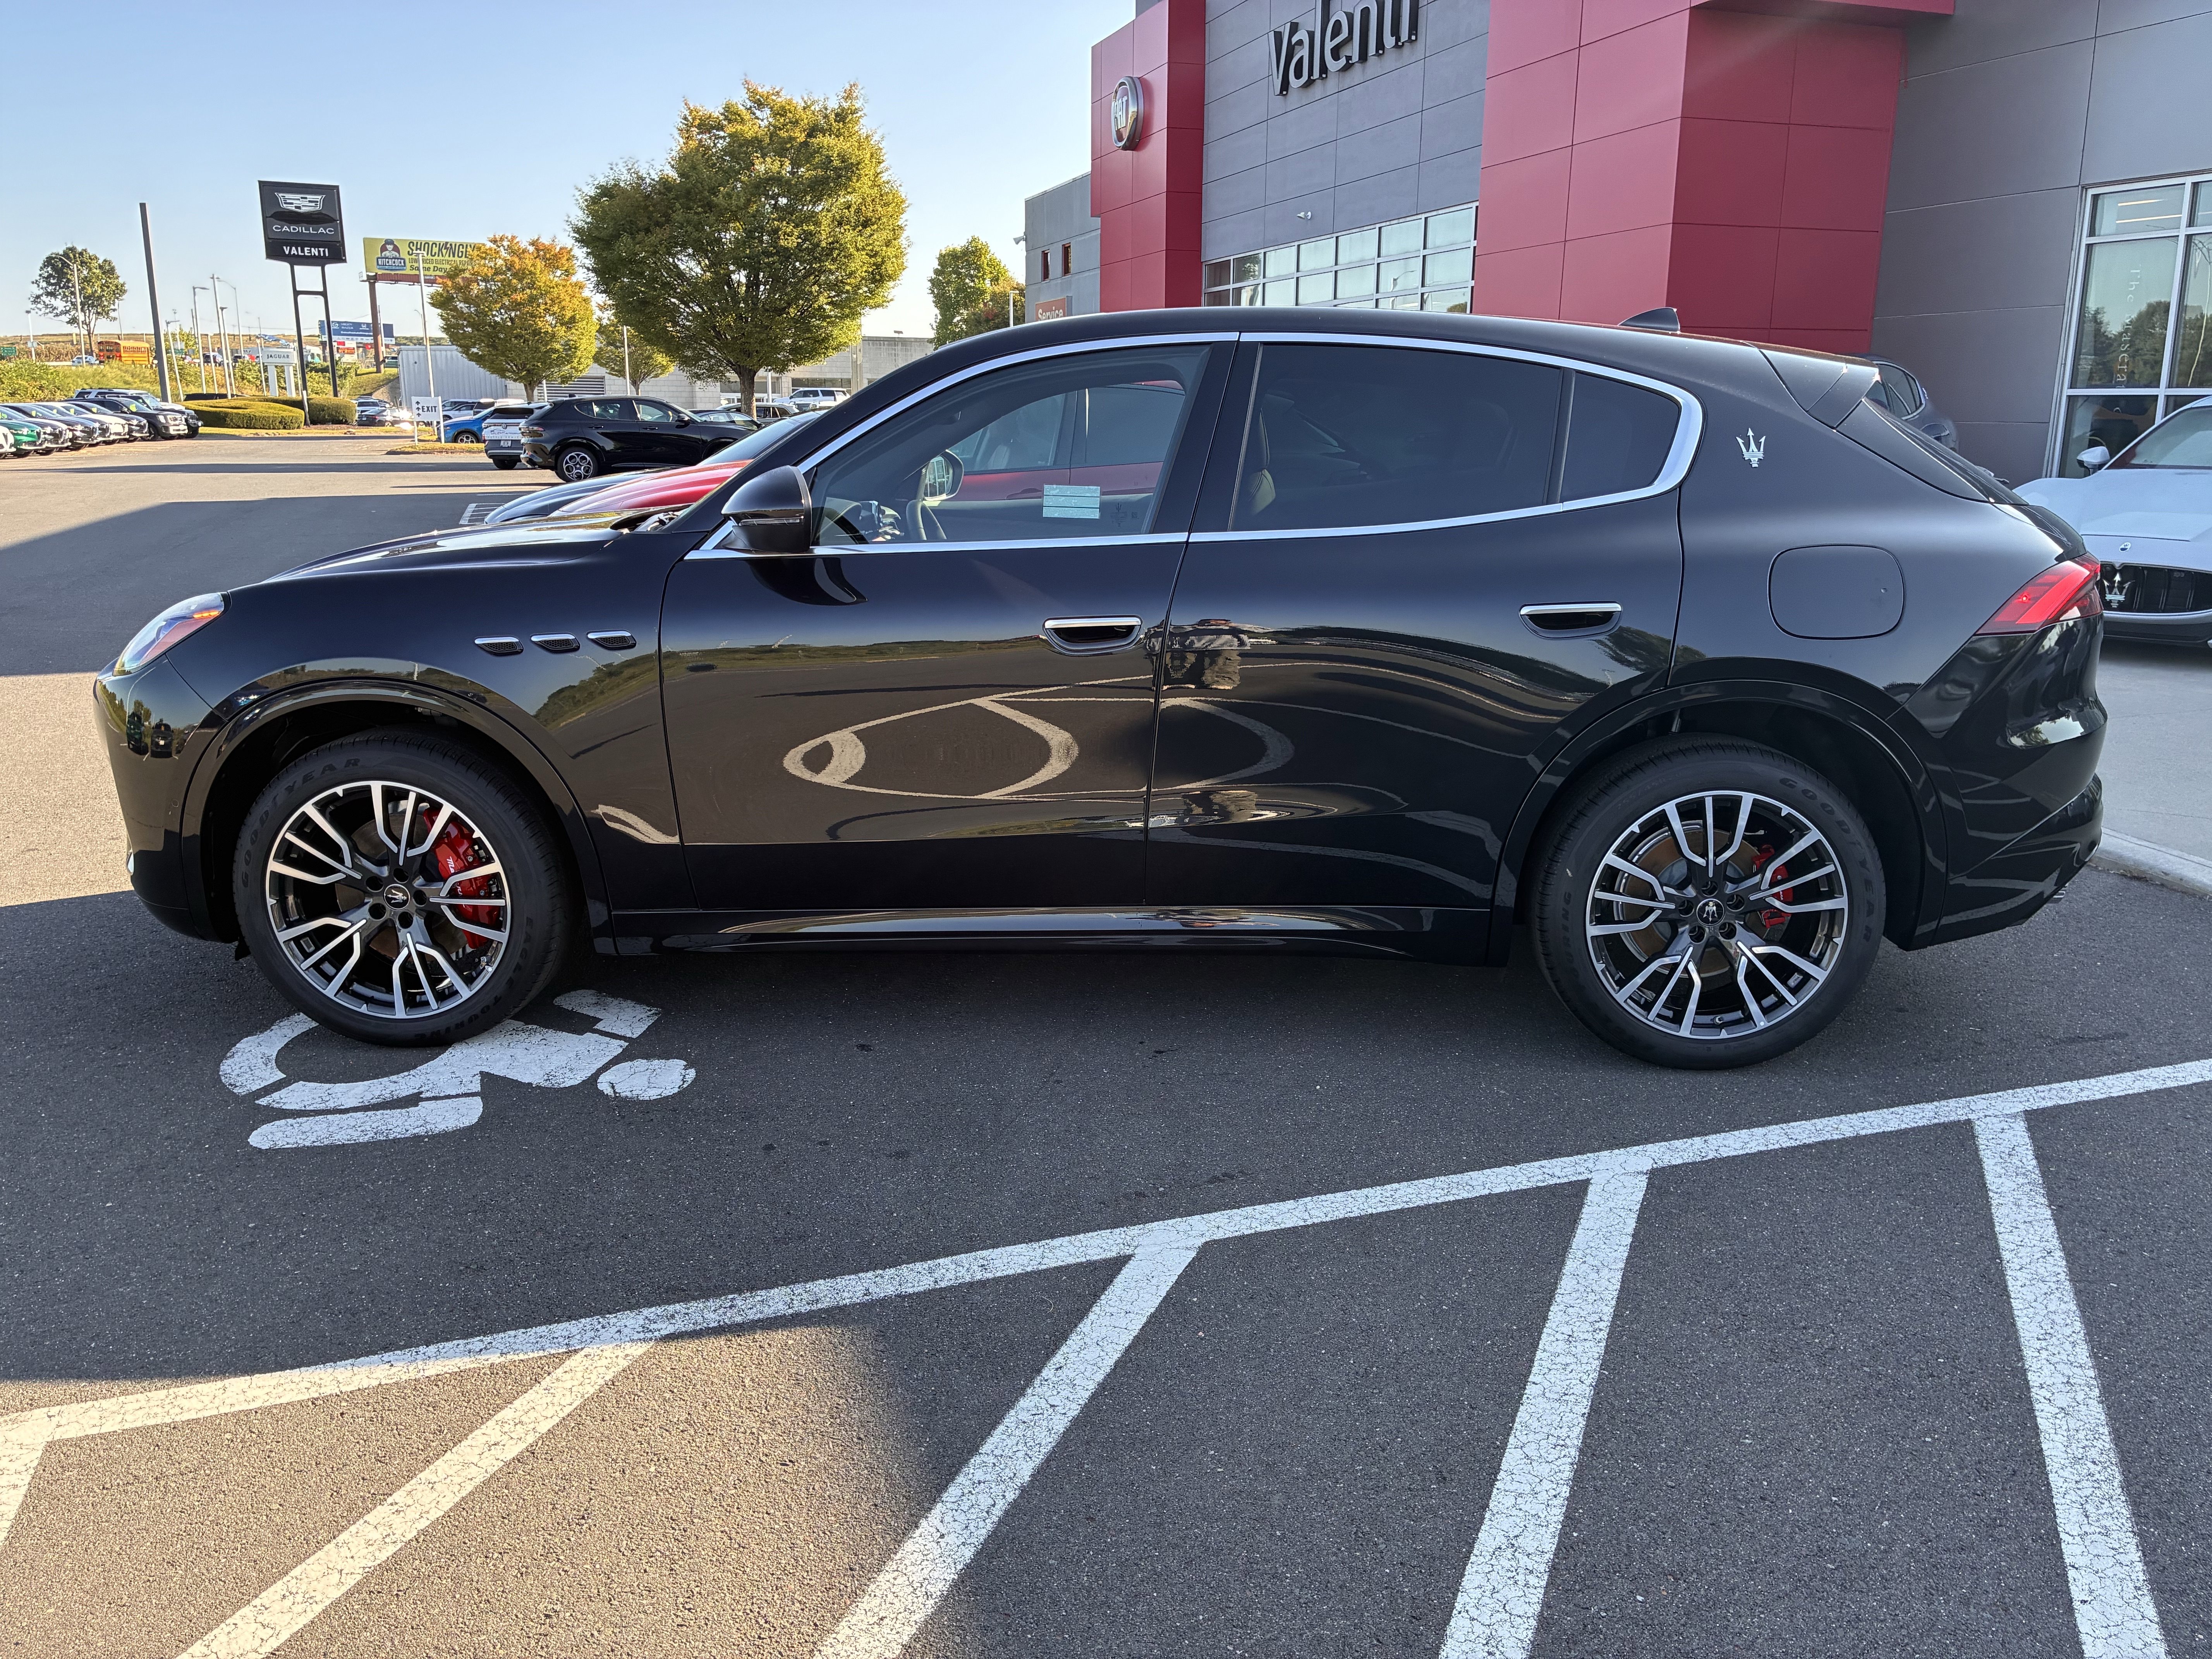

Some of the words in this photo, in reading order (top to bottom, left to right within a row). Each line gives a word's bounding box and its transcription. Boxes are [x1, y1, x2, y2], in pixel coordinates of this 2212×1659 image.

[273, 225, 334, 234] CADILLAC
[283, 246, 328, 256] VALENTI
[433, 266, 447, 274] Day
[1038, 306, 1063, 321] Service
